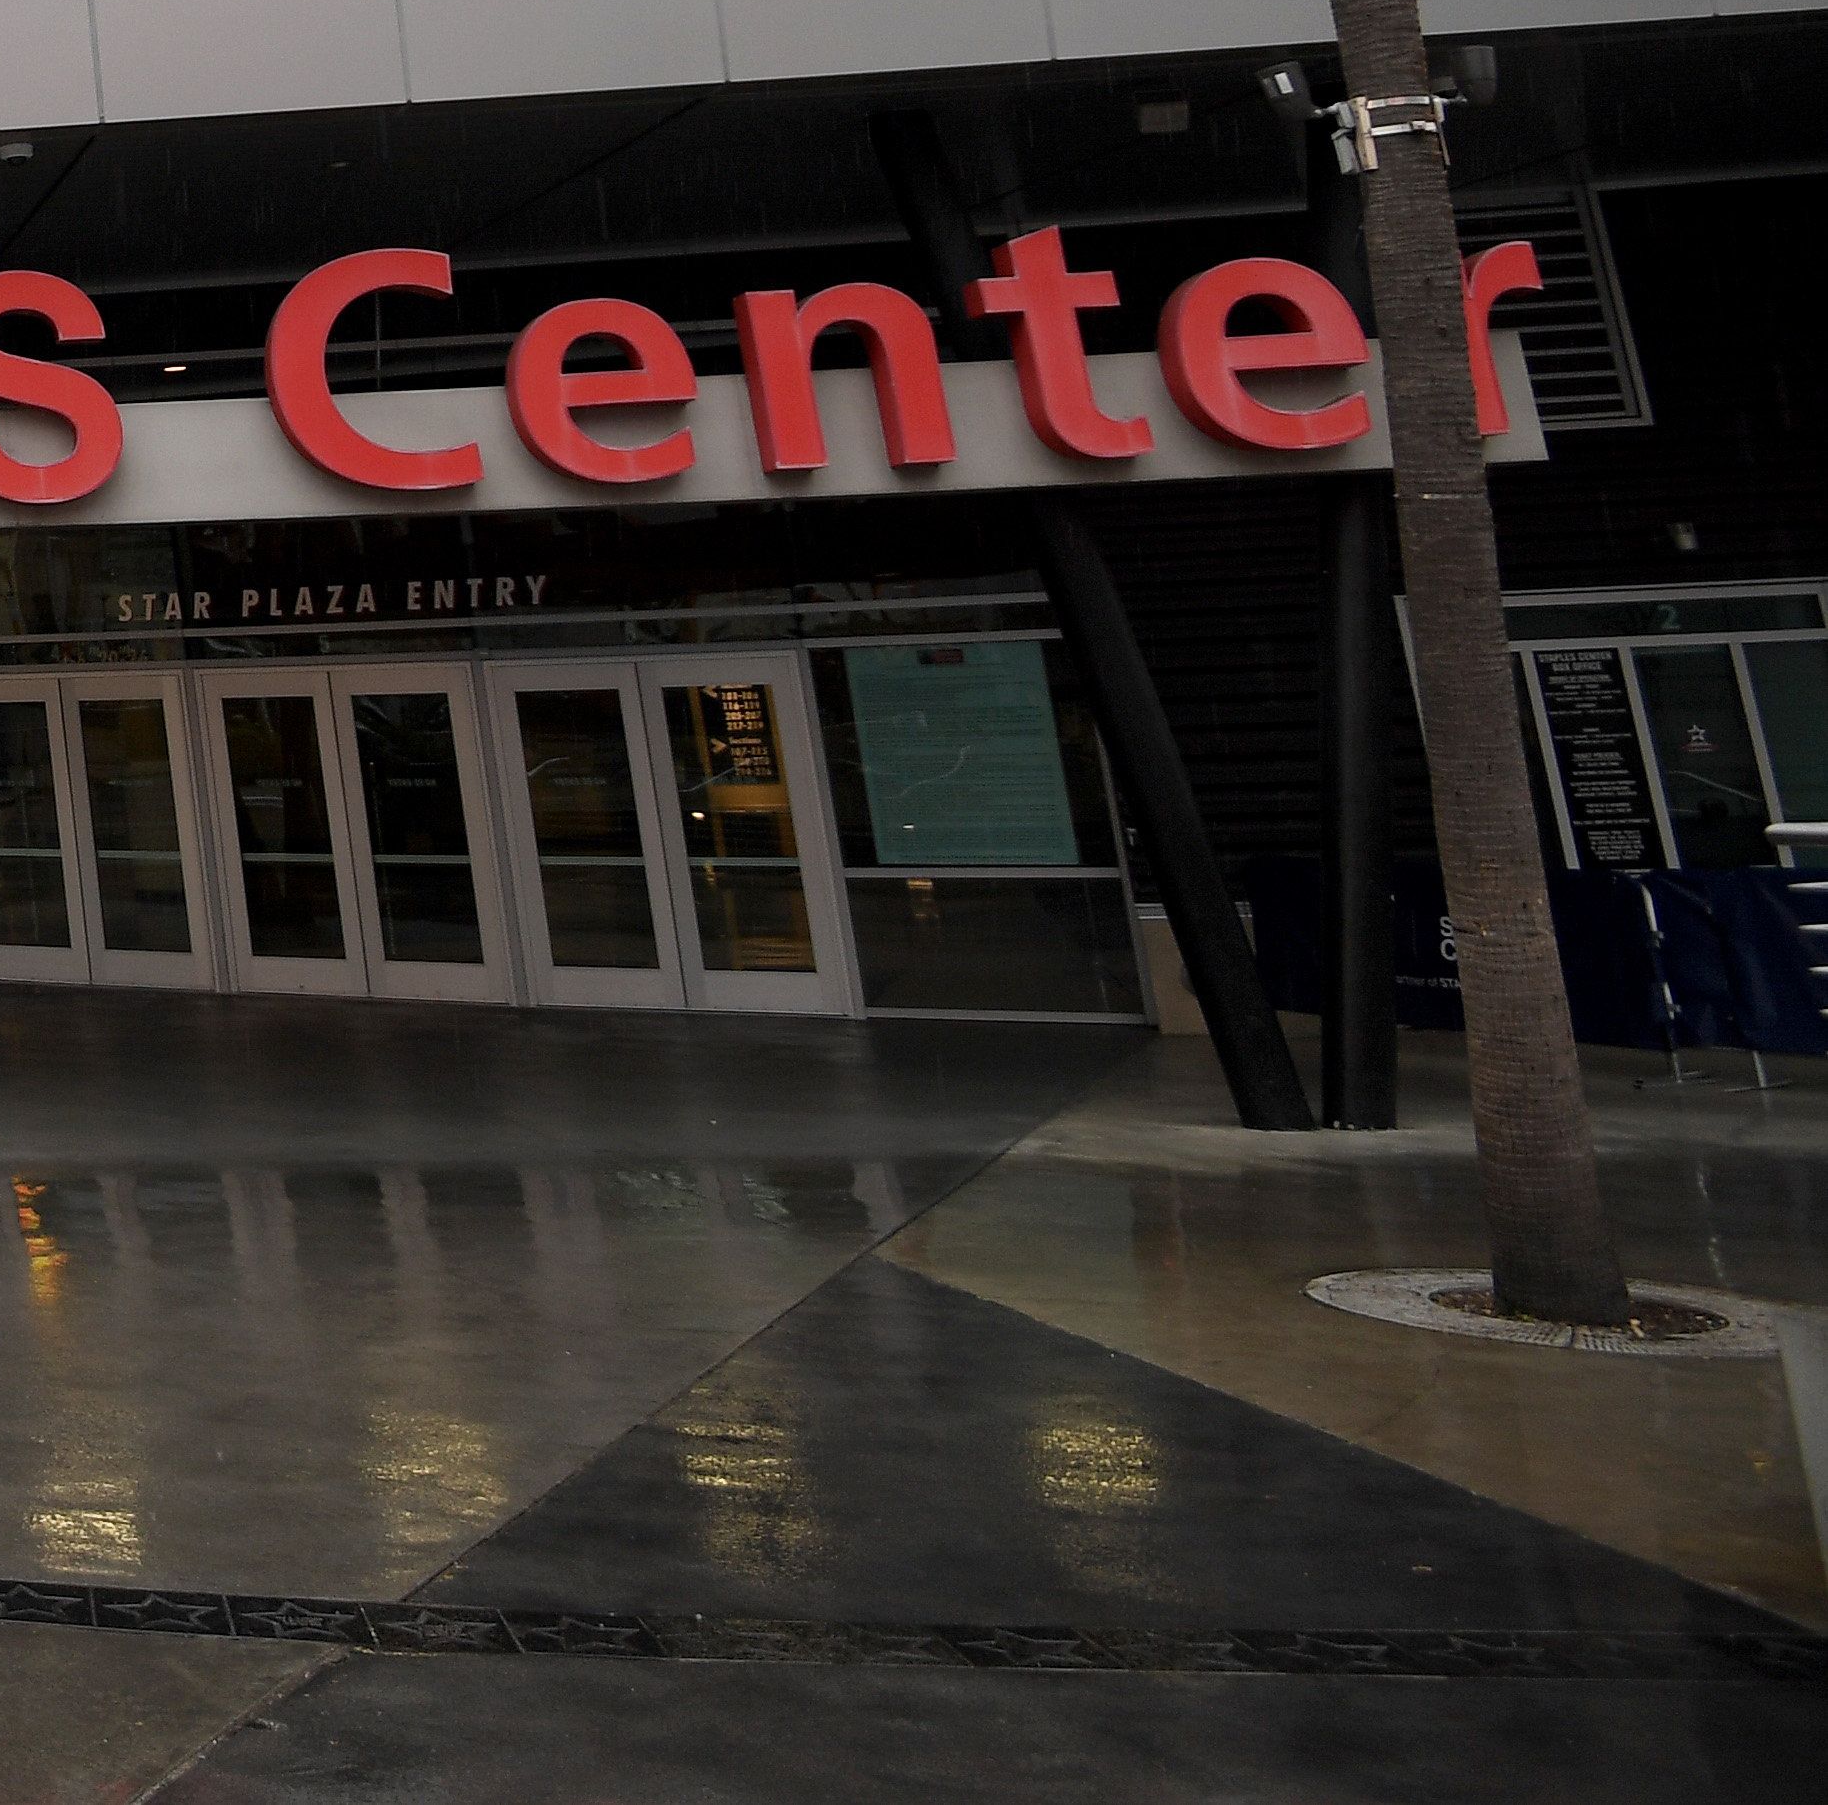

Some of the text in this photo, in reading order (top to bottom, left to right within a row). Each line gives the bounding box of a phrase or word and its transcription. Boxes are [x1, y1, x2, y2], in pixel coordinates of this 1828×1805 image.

[264, 224, 1543, 489] Center
[117, 574, 548, 623] STAR PLAZA ENTRY
[1657, 604, 1681, 630] 2
